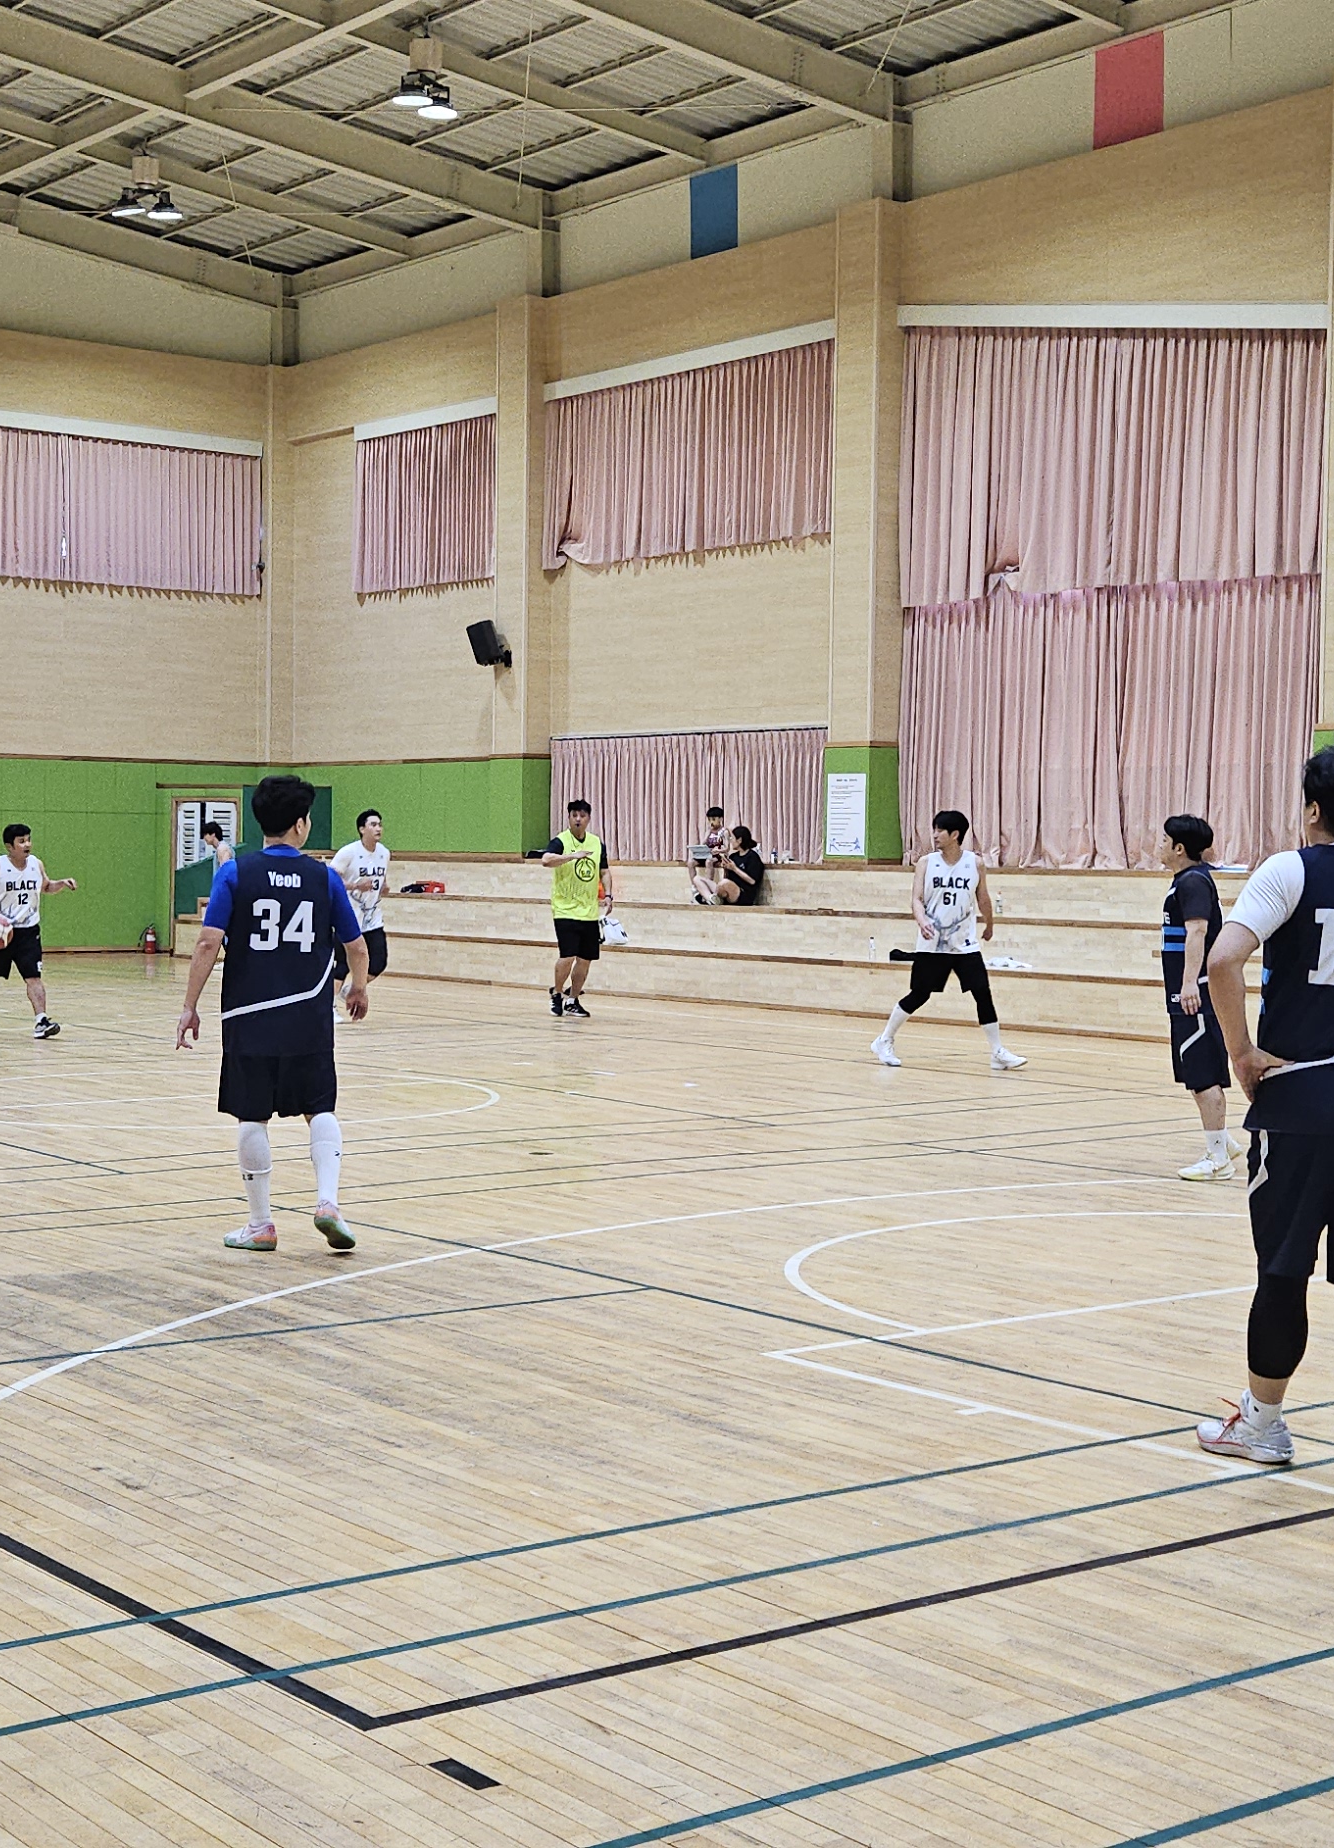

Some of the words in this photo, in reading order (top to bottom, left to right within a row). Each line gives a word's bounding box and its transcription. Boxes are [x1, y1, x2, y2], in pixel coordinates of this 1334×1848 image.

[5, 880, 38, 891] BLACK
[268, 871, 301, 888] Yeob
[933, 876, 971, 891] BLACK
[17, 893, 29, 905] 12
[943, 892, 957, 906] 61
[249, 898, 316, 953] 34
